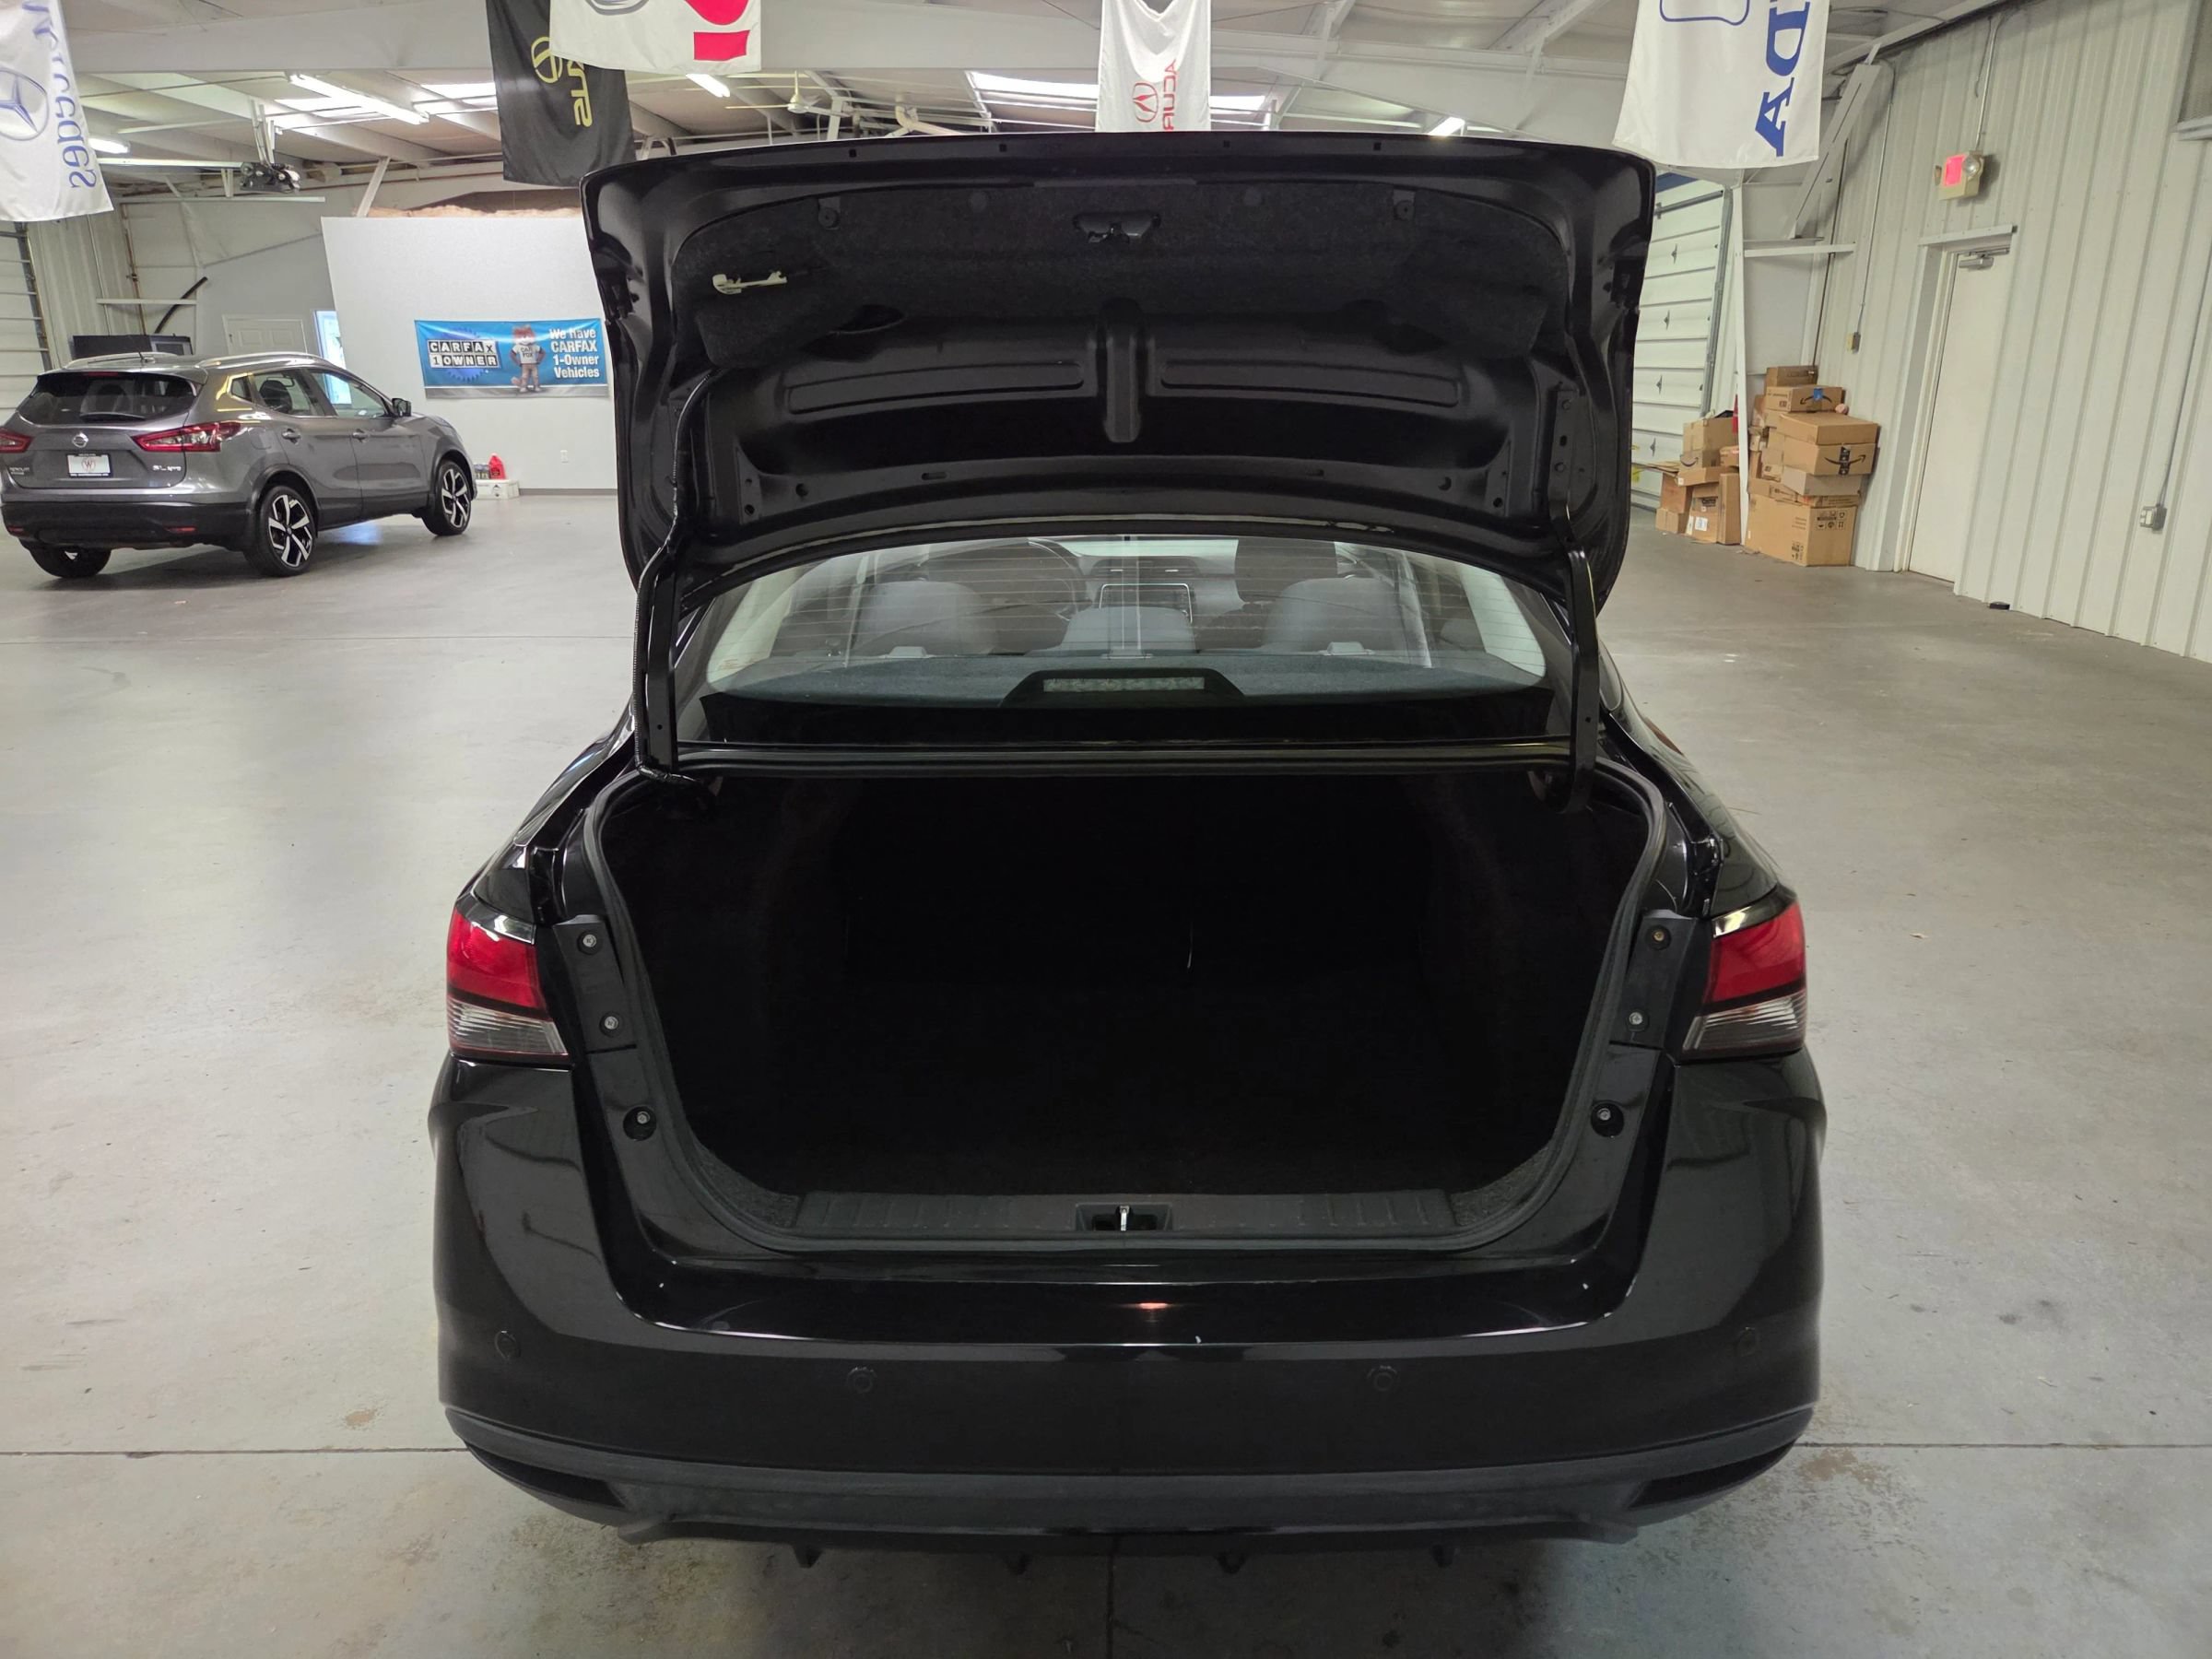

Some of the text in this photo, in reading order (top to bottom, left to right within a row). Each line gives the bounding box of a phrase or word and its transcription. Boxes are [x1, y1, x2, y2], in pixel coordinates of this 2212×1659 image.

[548, 328, 567, 339] We
[429, 341, 493, 353] CARFAX
[550, 339, 598, 353] CARFAX
[553, 354, 599, 366] 1-Owner
[553, 366, 600, 378] Vehicles
